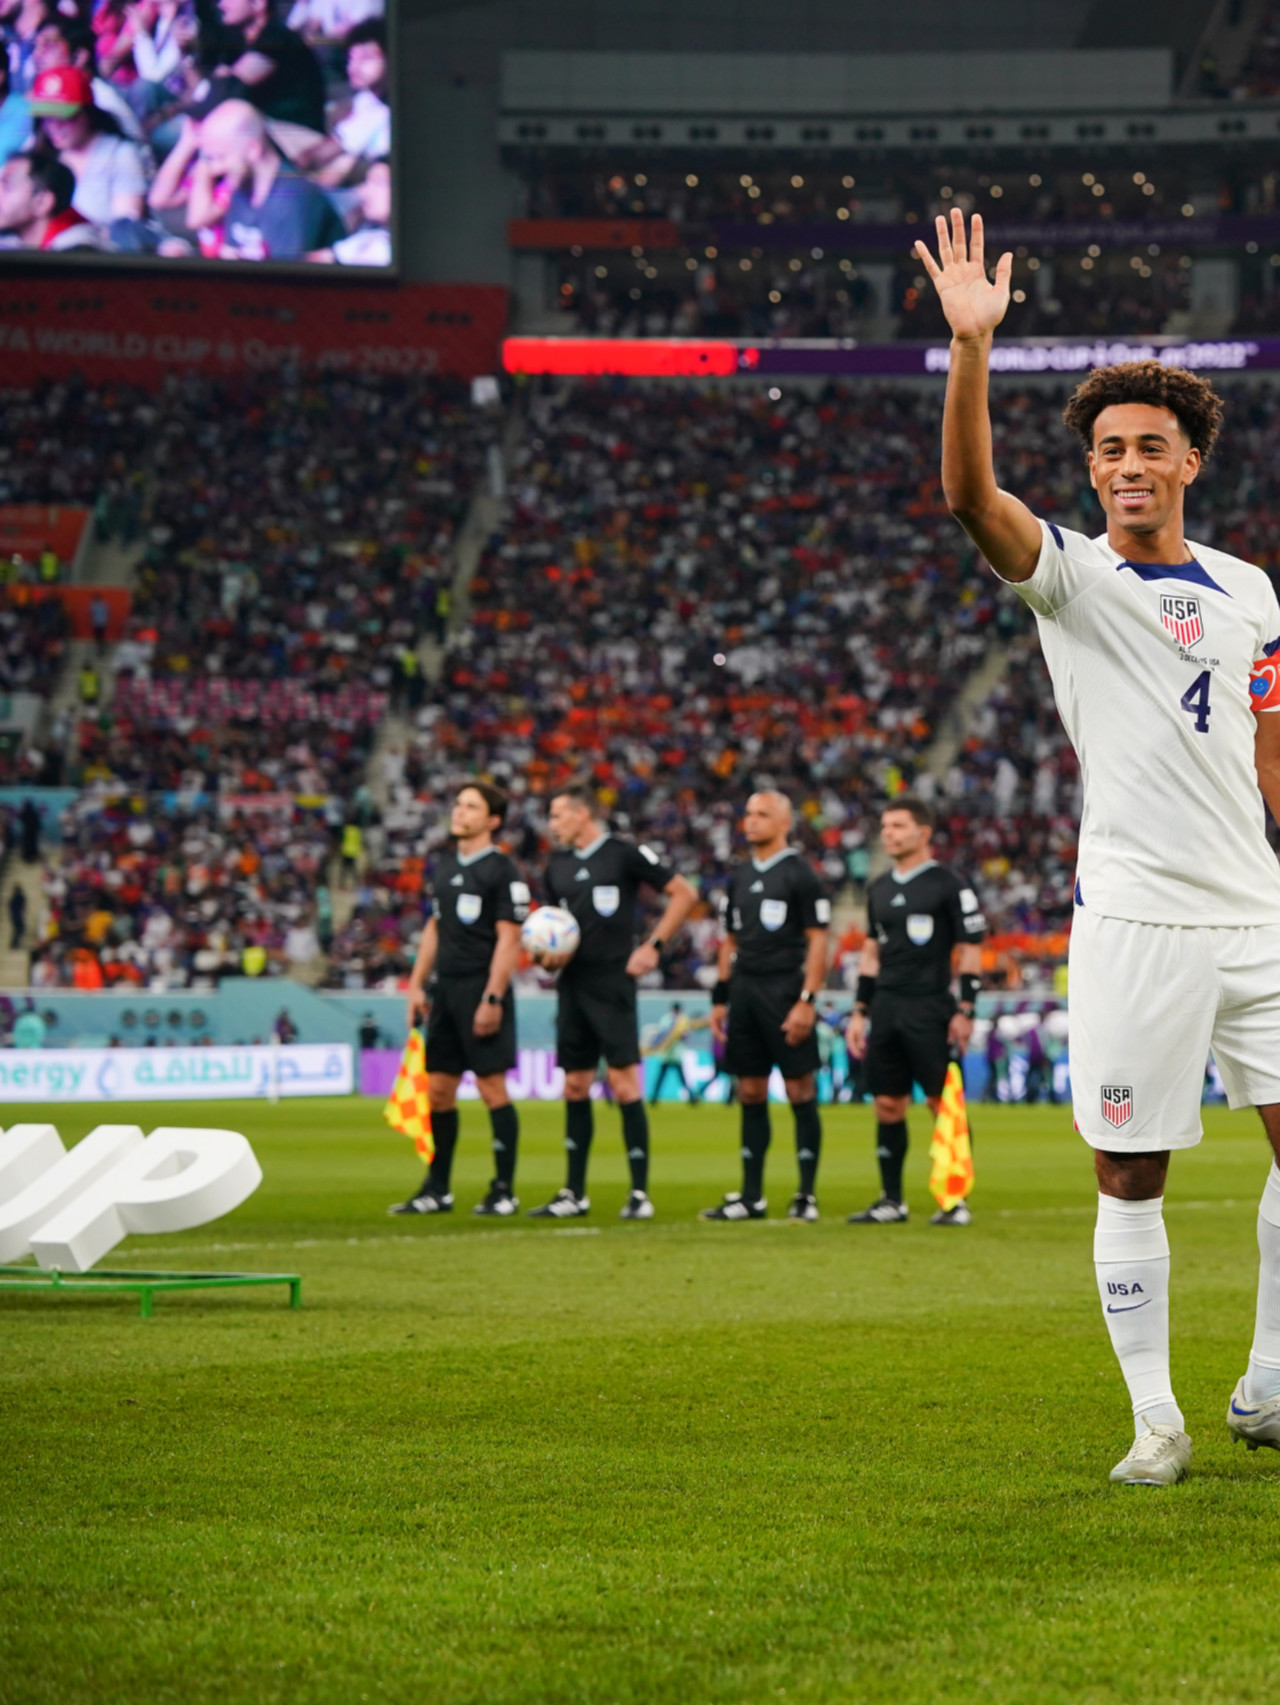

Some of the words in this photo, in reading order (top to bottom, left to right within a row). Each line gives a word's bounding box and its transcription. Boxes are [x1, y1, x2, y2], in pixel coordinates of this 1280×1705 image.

[34, 326, 147, 355] WORLD
[151, 331, 213, 357] CUP
[1163, 599, 1197, 620] USA
[1180, 670, 1211, 733] 4
[1103, 1088, 1130, 1104] USA
[1107, 1281, 1144, 1296] USA
